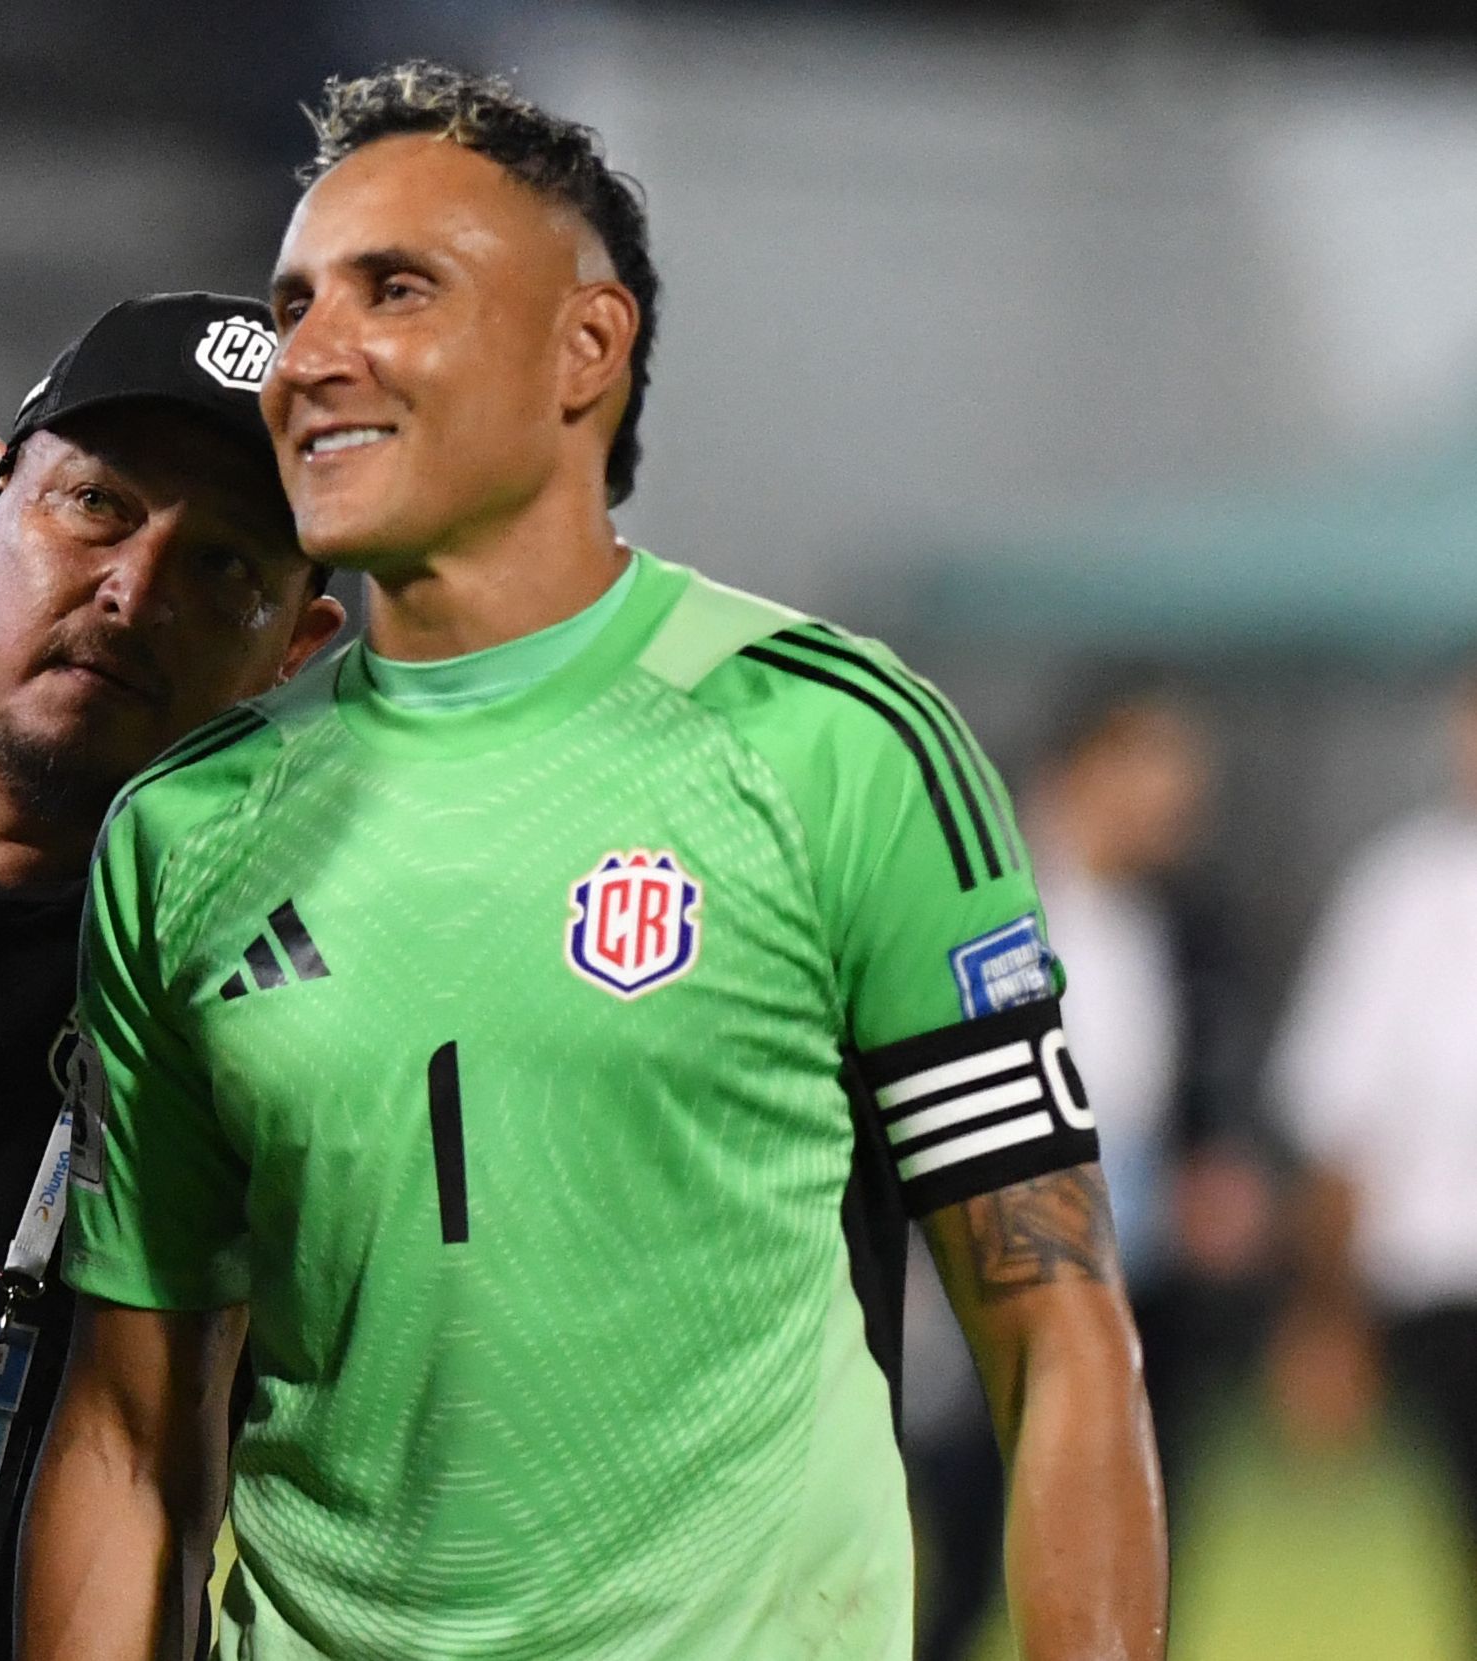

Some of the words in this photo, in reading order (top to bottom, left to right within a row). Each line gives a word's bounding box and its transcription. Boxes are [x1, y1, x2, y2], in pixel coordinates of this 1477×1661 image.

[211, 325, 273, 380] CR
[595, 877, 671, 970] CR
[427, 1039, 470, 1244] 1
